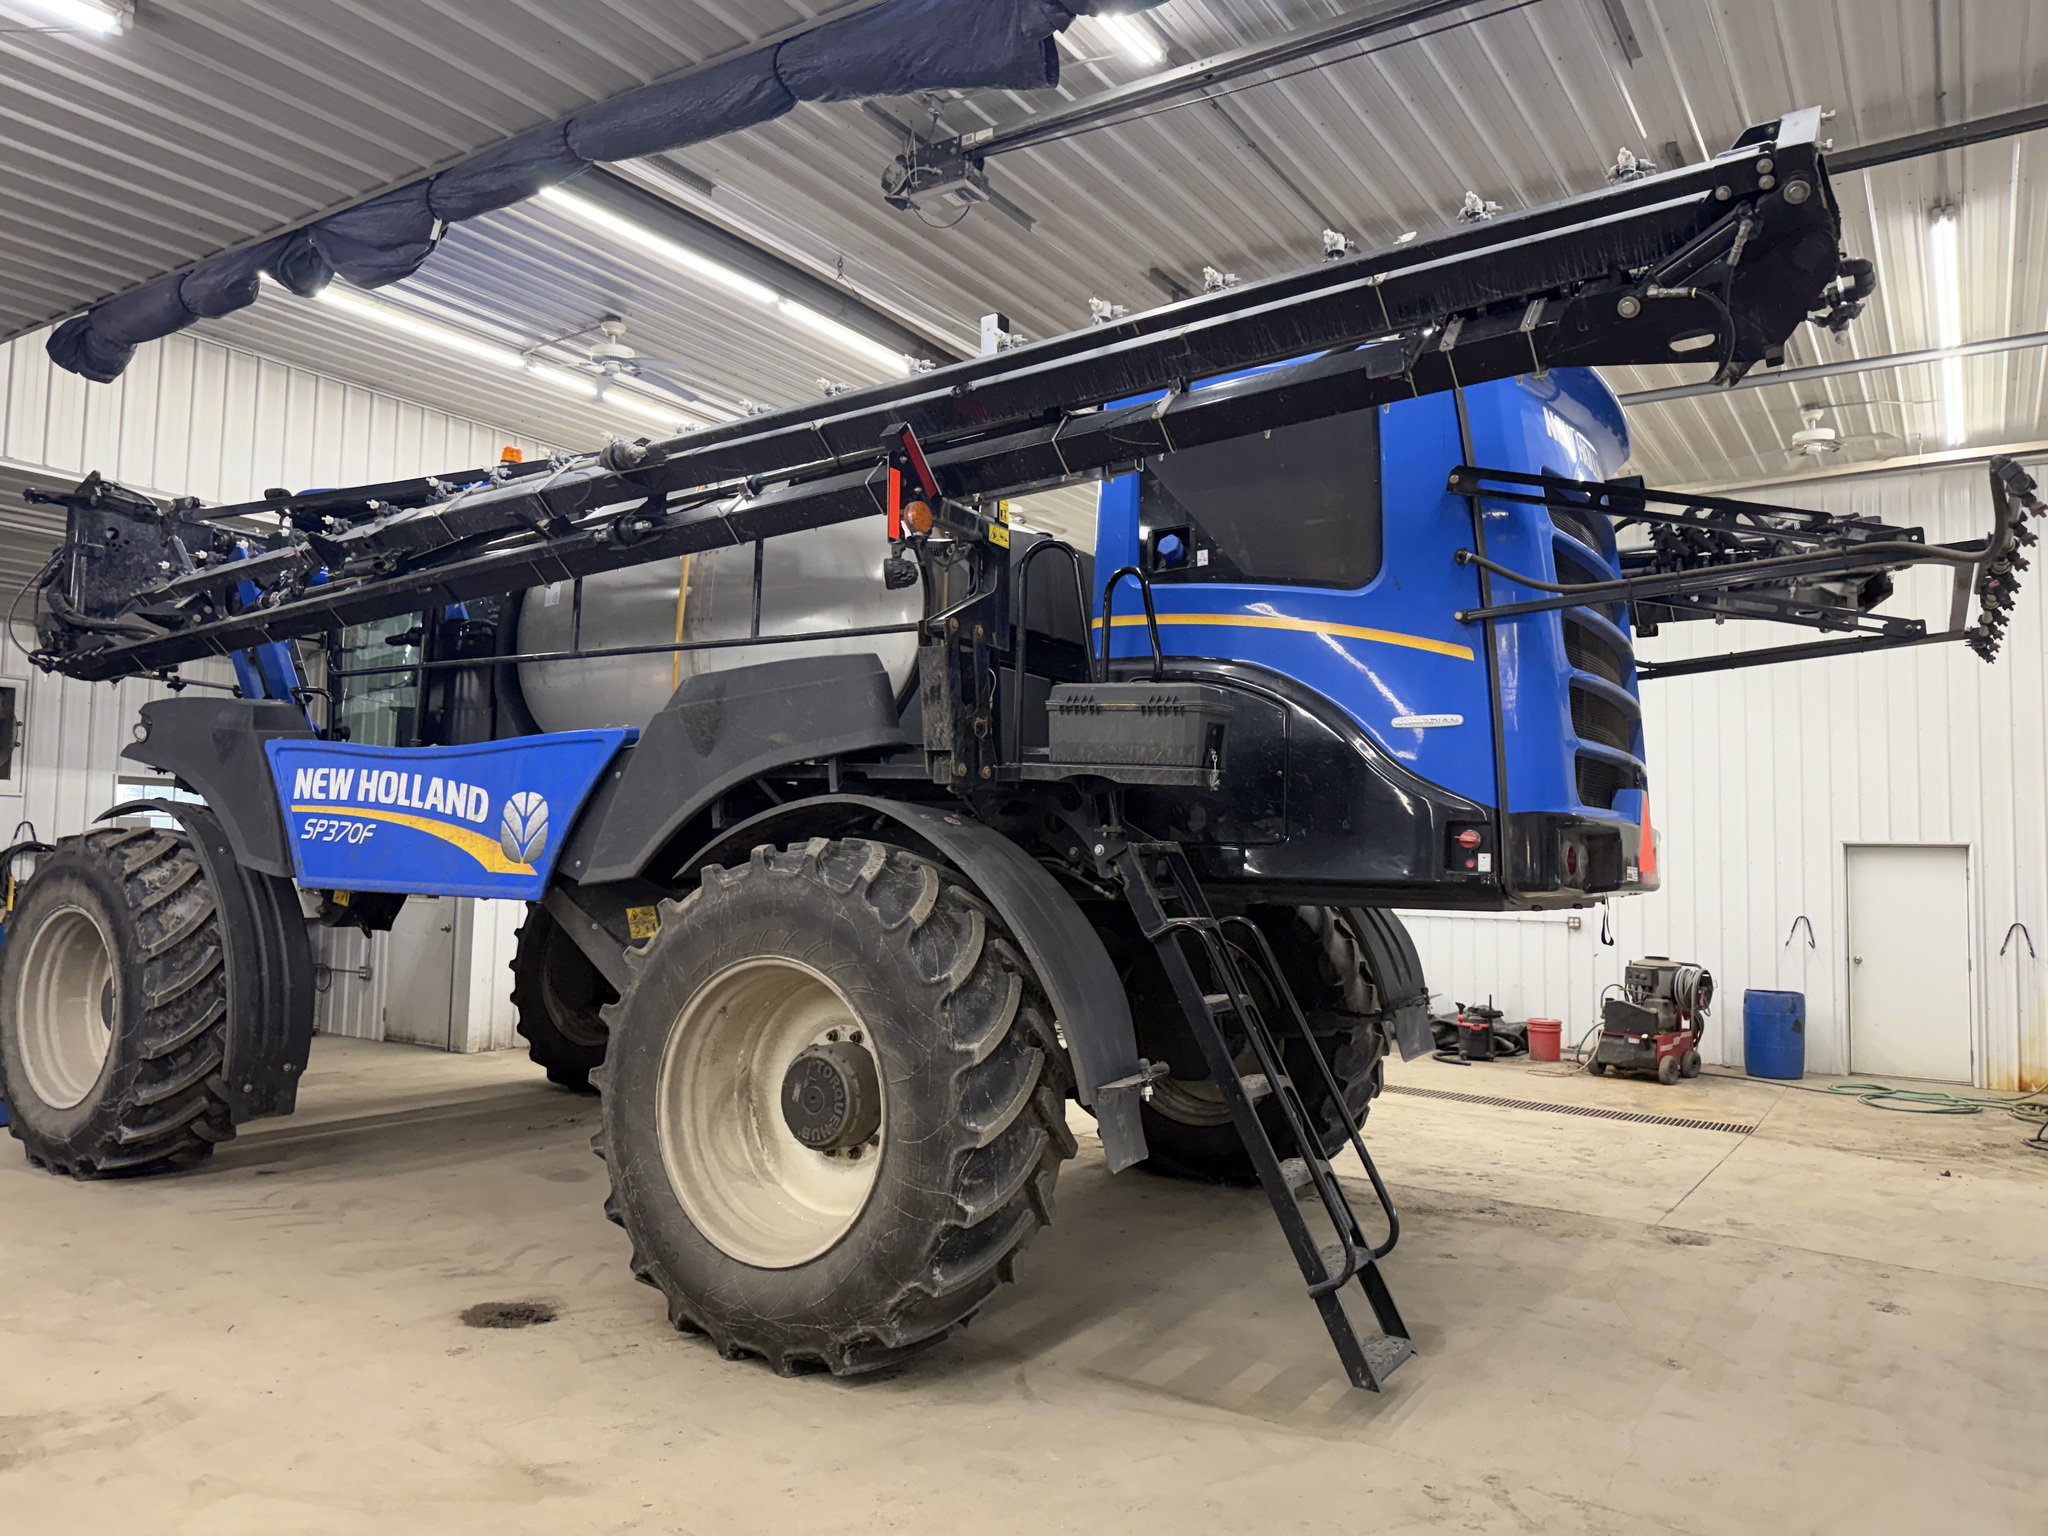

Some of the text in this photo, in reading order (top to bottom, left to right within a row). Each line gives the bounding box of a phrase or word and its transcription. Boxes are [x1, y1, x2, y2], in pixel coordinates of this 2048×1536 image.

[293, 768, 490, 824] NEW HOLLAND
[301, 818, 377, 845] SP370F
